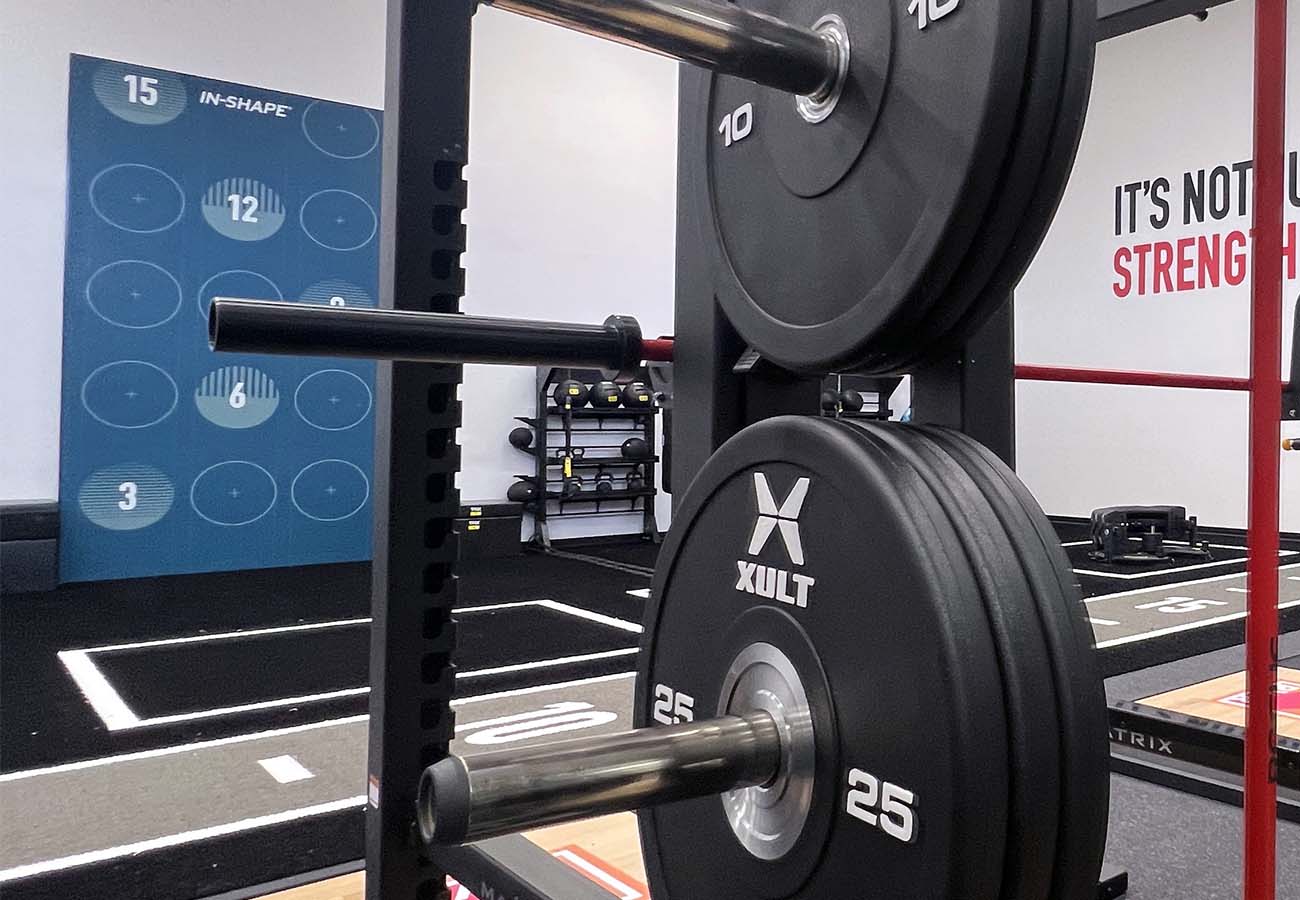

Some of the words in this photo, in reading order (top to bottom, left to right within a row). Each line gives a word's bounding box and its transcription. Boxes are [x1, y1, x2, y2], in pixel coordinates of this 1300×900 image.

[124, 74, 158, 106] 15
[718, 102, 753, 147] 10
[228, 194, 258, 223] 12
[1183, 159, 1253, 225] NOT
[229, 382, 246, 409] 6
[118, 482, 137, 510] 3
[735, 560, 816, 608] XULT
[1133, 595, 1230, 614] 15
[653, 683, 695, 725] 25
[846, 767, 915, 842] 25
